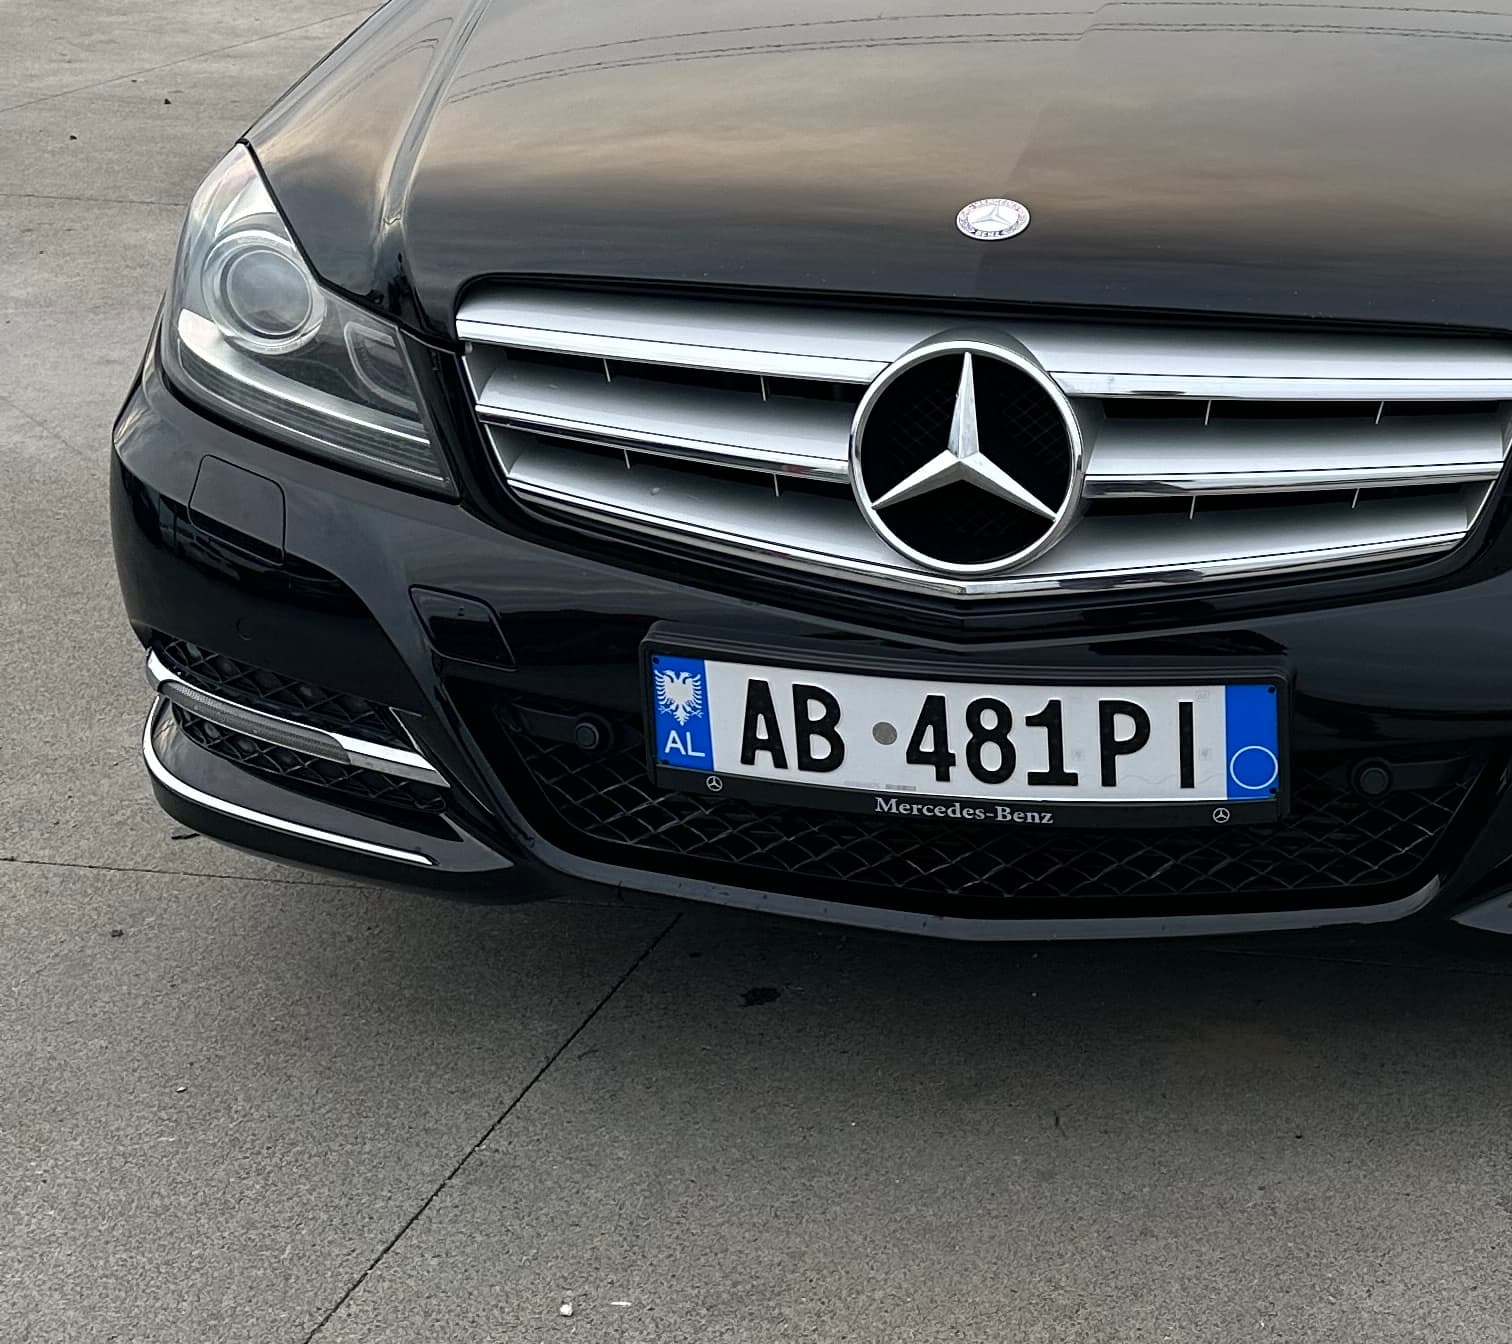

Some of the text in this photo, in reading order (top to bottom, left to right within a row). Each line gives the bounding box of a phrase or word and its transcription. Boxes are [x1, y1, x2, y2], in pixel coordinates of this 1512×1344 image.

[665, 730, 705, 757] AL
[741, 678, 1195, 789] AB 481PI
[874, 797, 1054, 824] Mercedes-Benz
